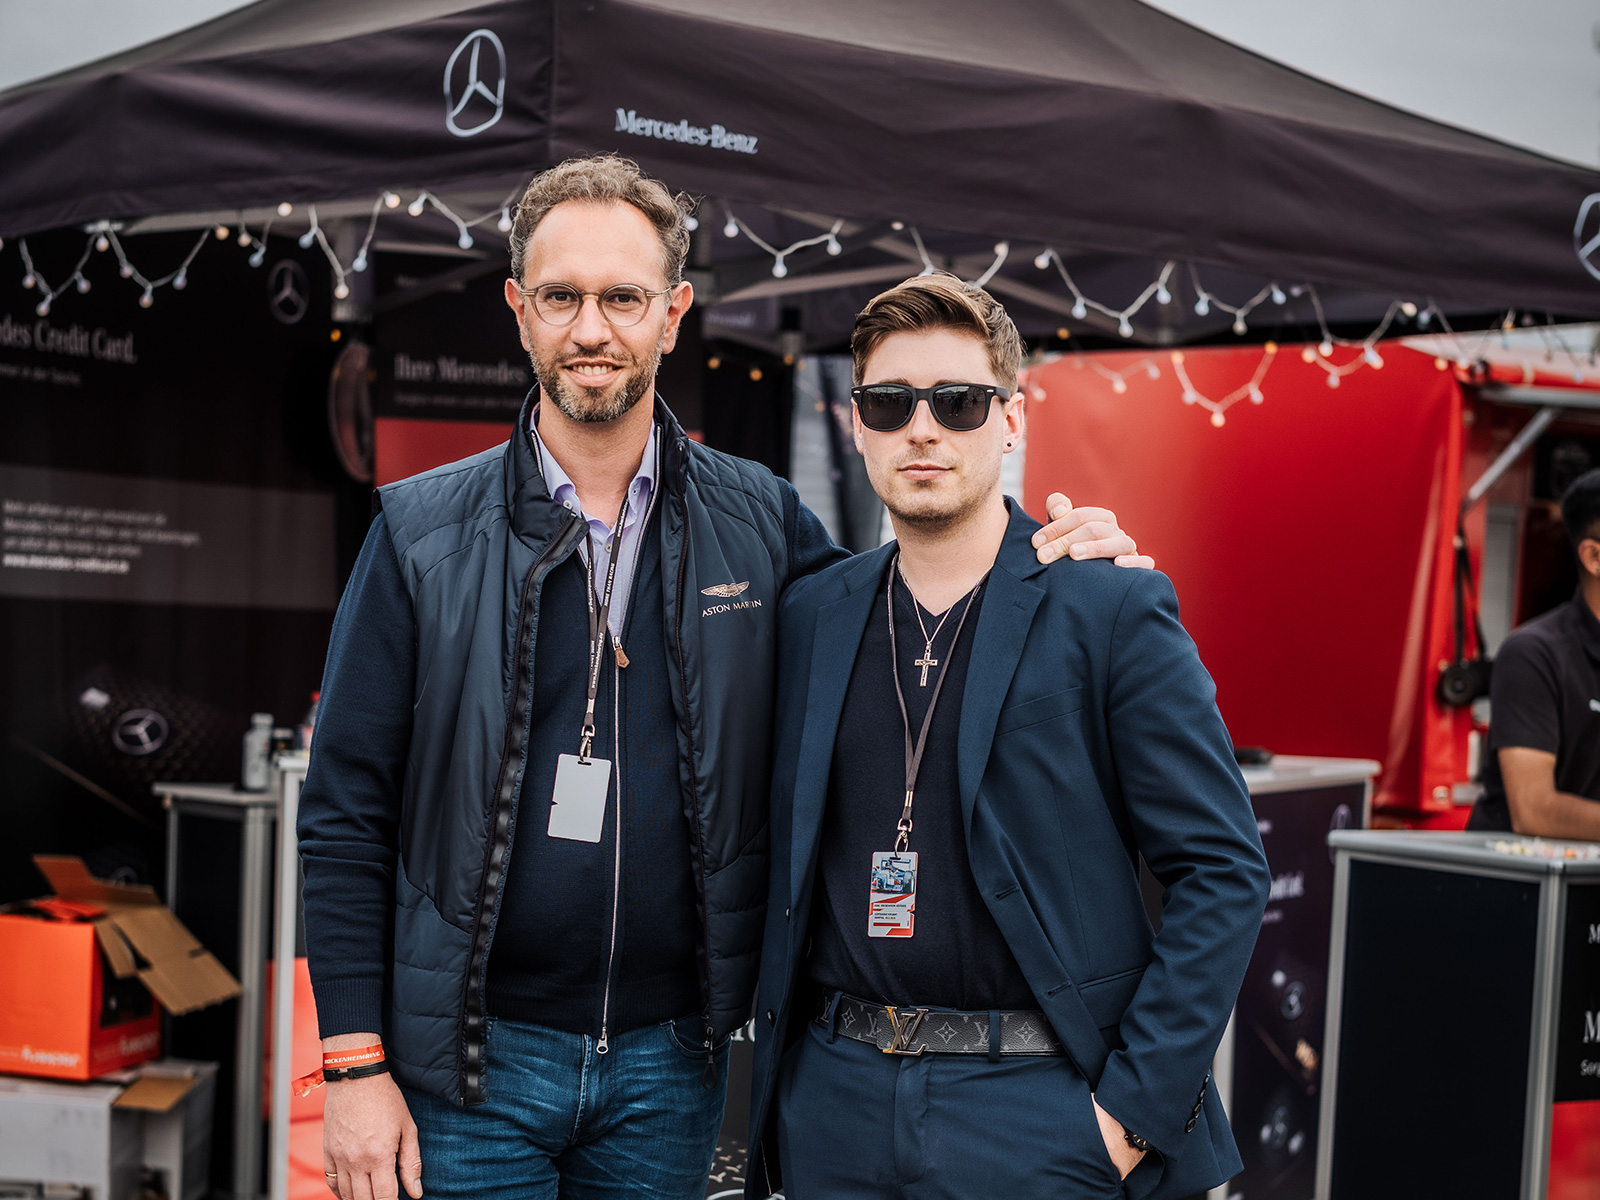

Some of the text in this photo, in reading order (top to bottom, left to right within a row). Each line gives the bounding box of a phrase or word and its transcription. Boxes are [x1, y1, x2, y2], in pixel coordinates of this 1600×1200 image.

[614, 107, 759, 155] Mercedes-Benz
[33, 318, 90, 359] Credit
[393, 352, 435, 382] Ihre
[702, 603, 731, 618] ASTON
